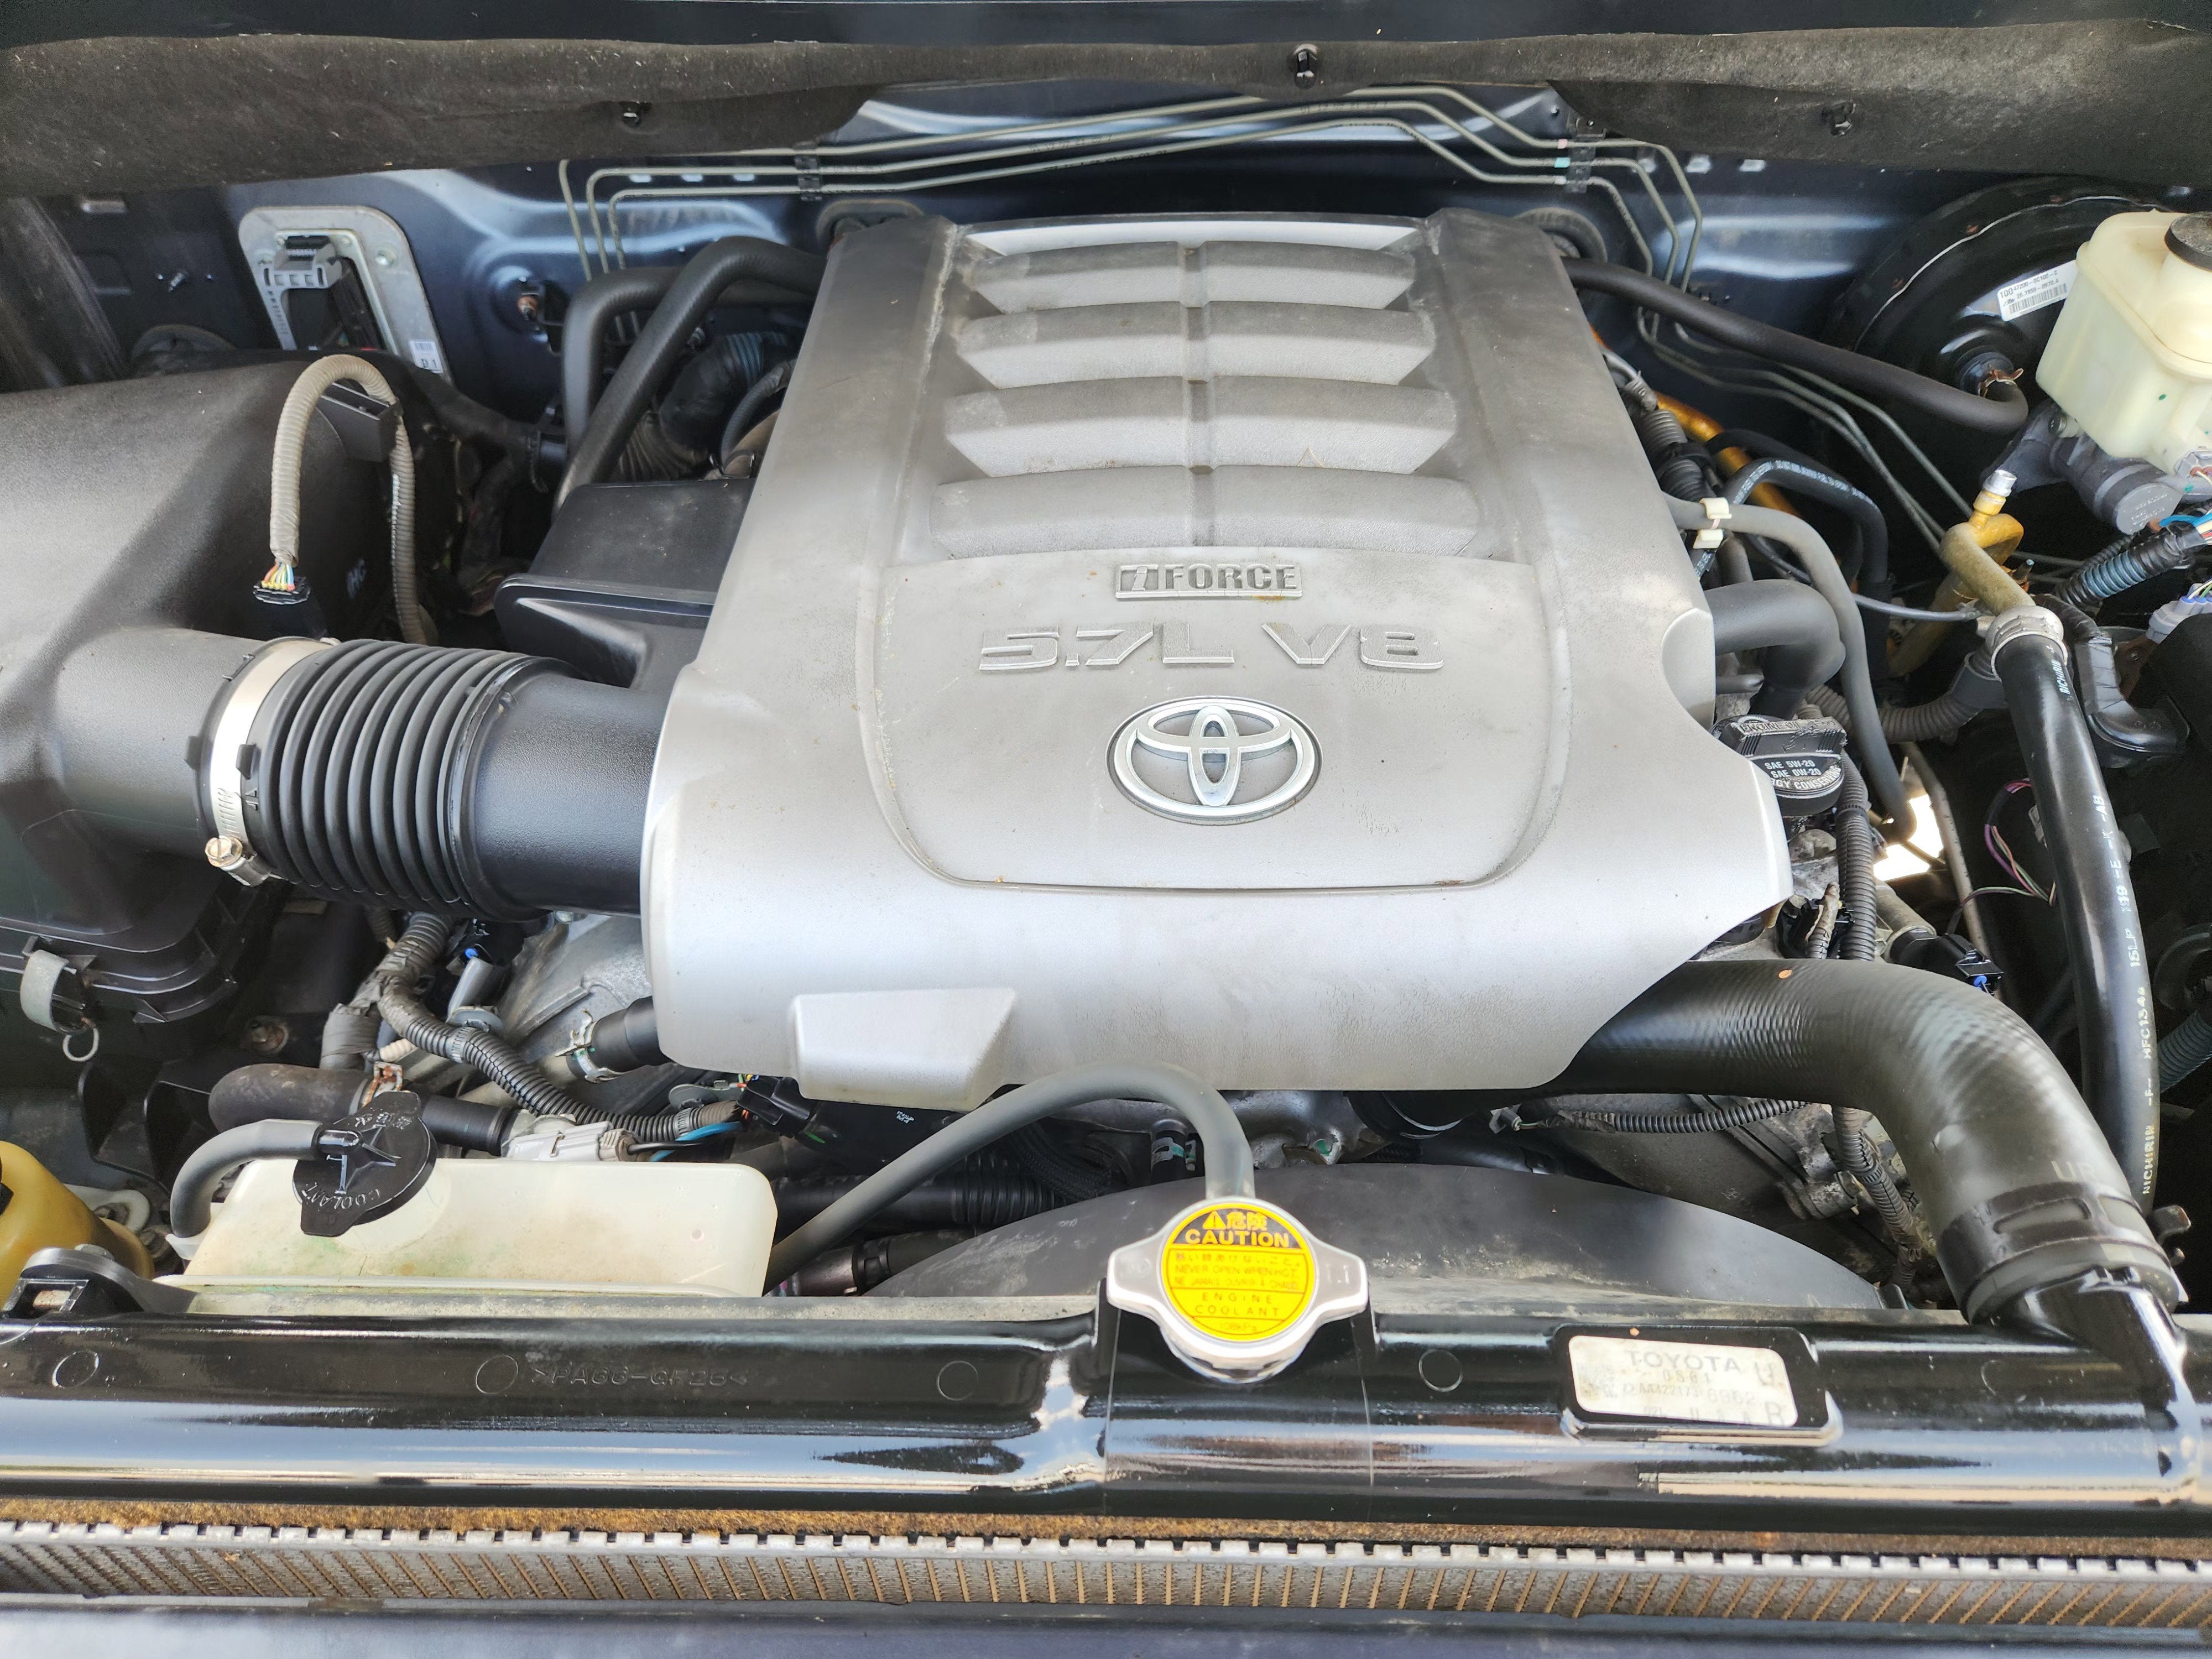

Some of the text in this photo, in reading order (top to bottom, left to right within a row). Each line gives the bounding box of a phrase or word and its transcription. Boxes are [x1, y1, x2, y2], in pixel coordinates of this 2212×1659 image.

[978, 620, 1444, 671] 5.7L V8
[1764, 759, 1816, 770] SAE 5W-20
[1770, 768, 1823, 779] SAE 0W-20
[1185, 1228, 1290, 1248] CAUTION
[1202, 1291, 1272, 1305] ENGINE
[1194, 1304, 1280, 1316] COOLANT
[1626, 1350, 1742, 1374] TOYOTA
